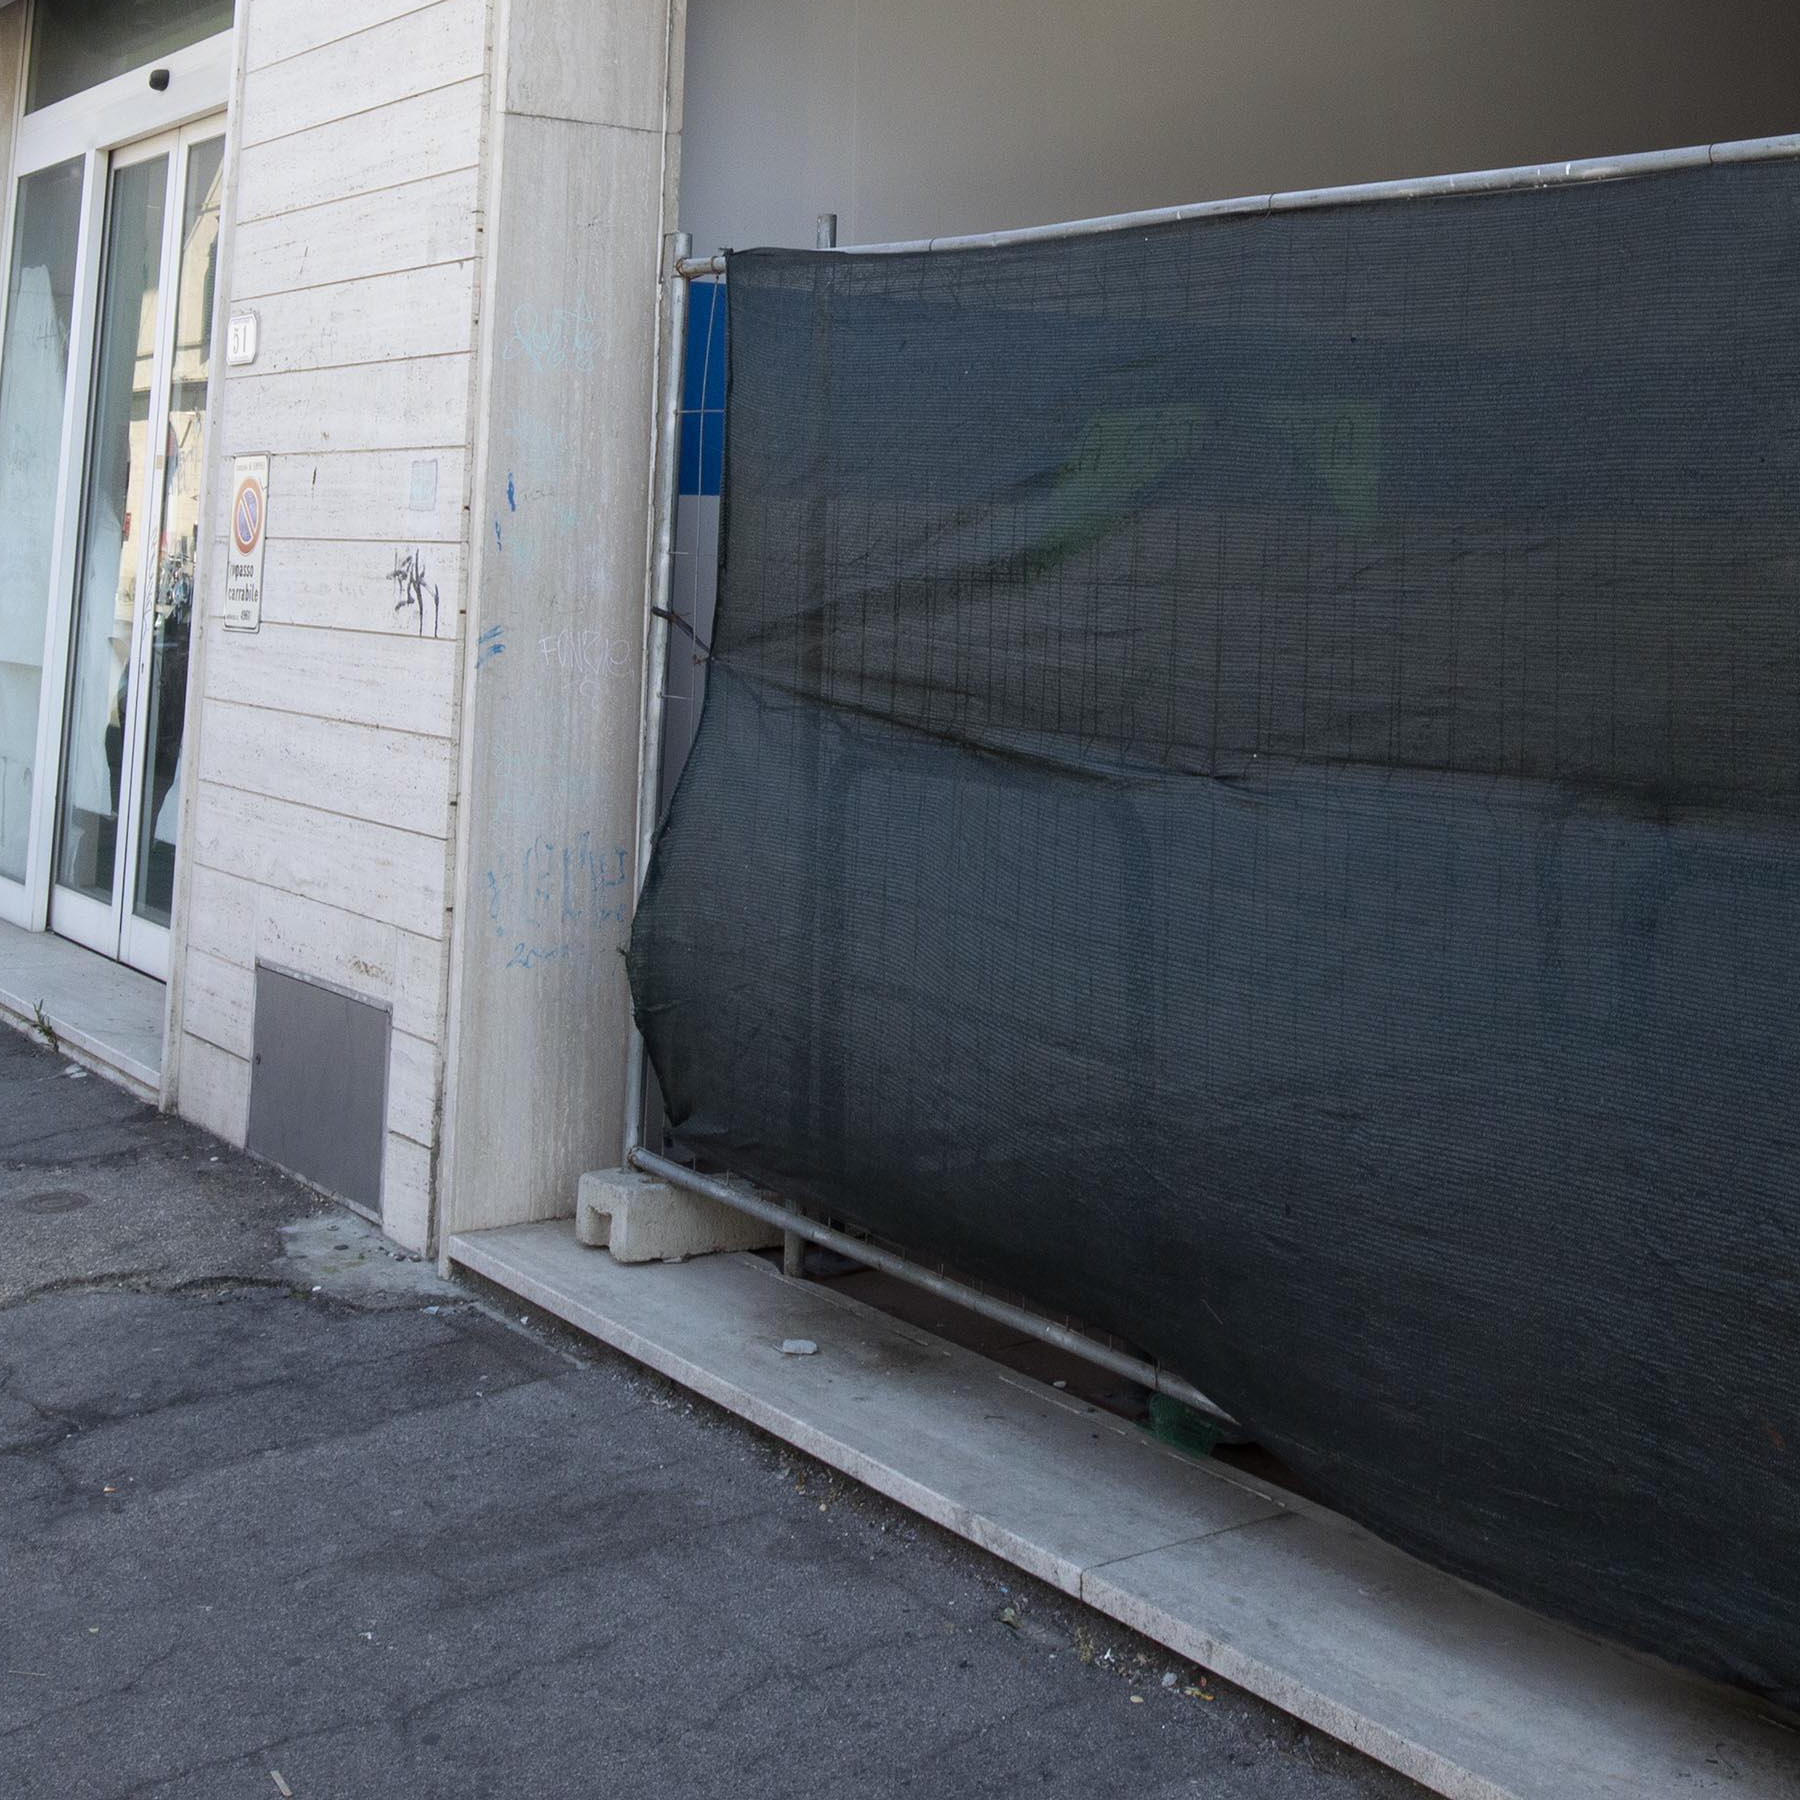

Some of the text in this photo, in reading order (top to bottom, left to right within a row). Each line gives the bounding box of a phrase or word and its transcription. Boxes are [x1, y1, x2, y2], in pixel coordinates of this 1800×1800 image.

[233, 325, 247, 354] 51
[235, 564, 254, 580] passo
[228, 583, 258, 602] carrabile
